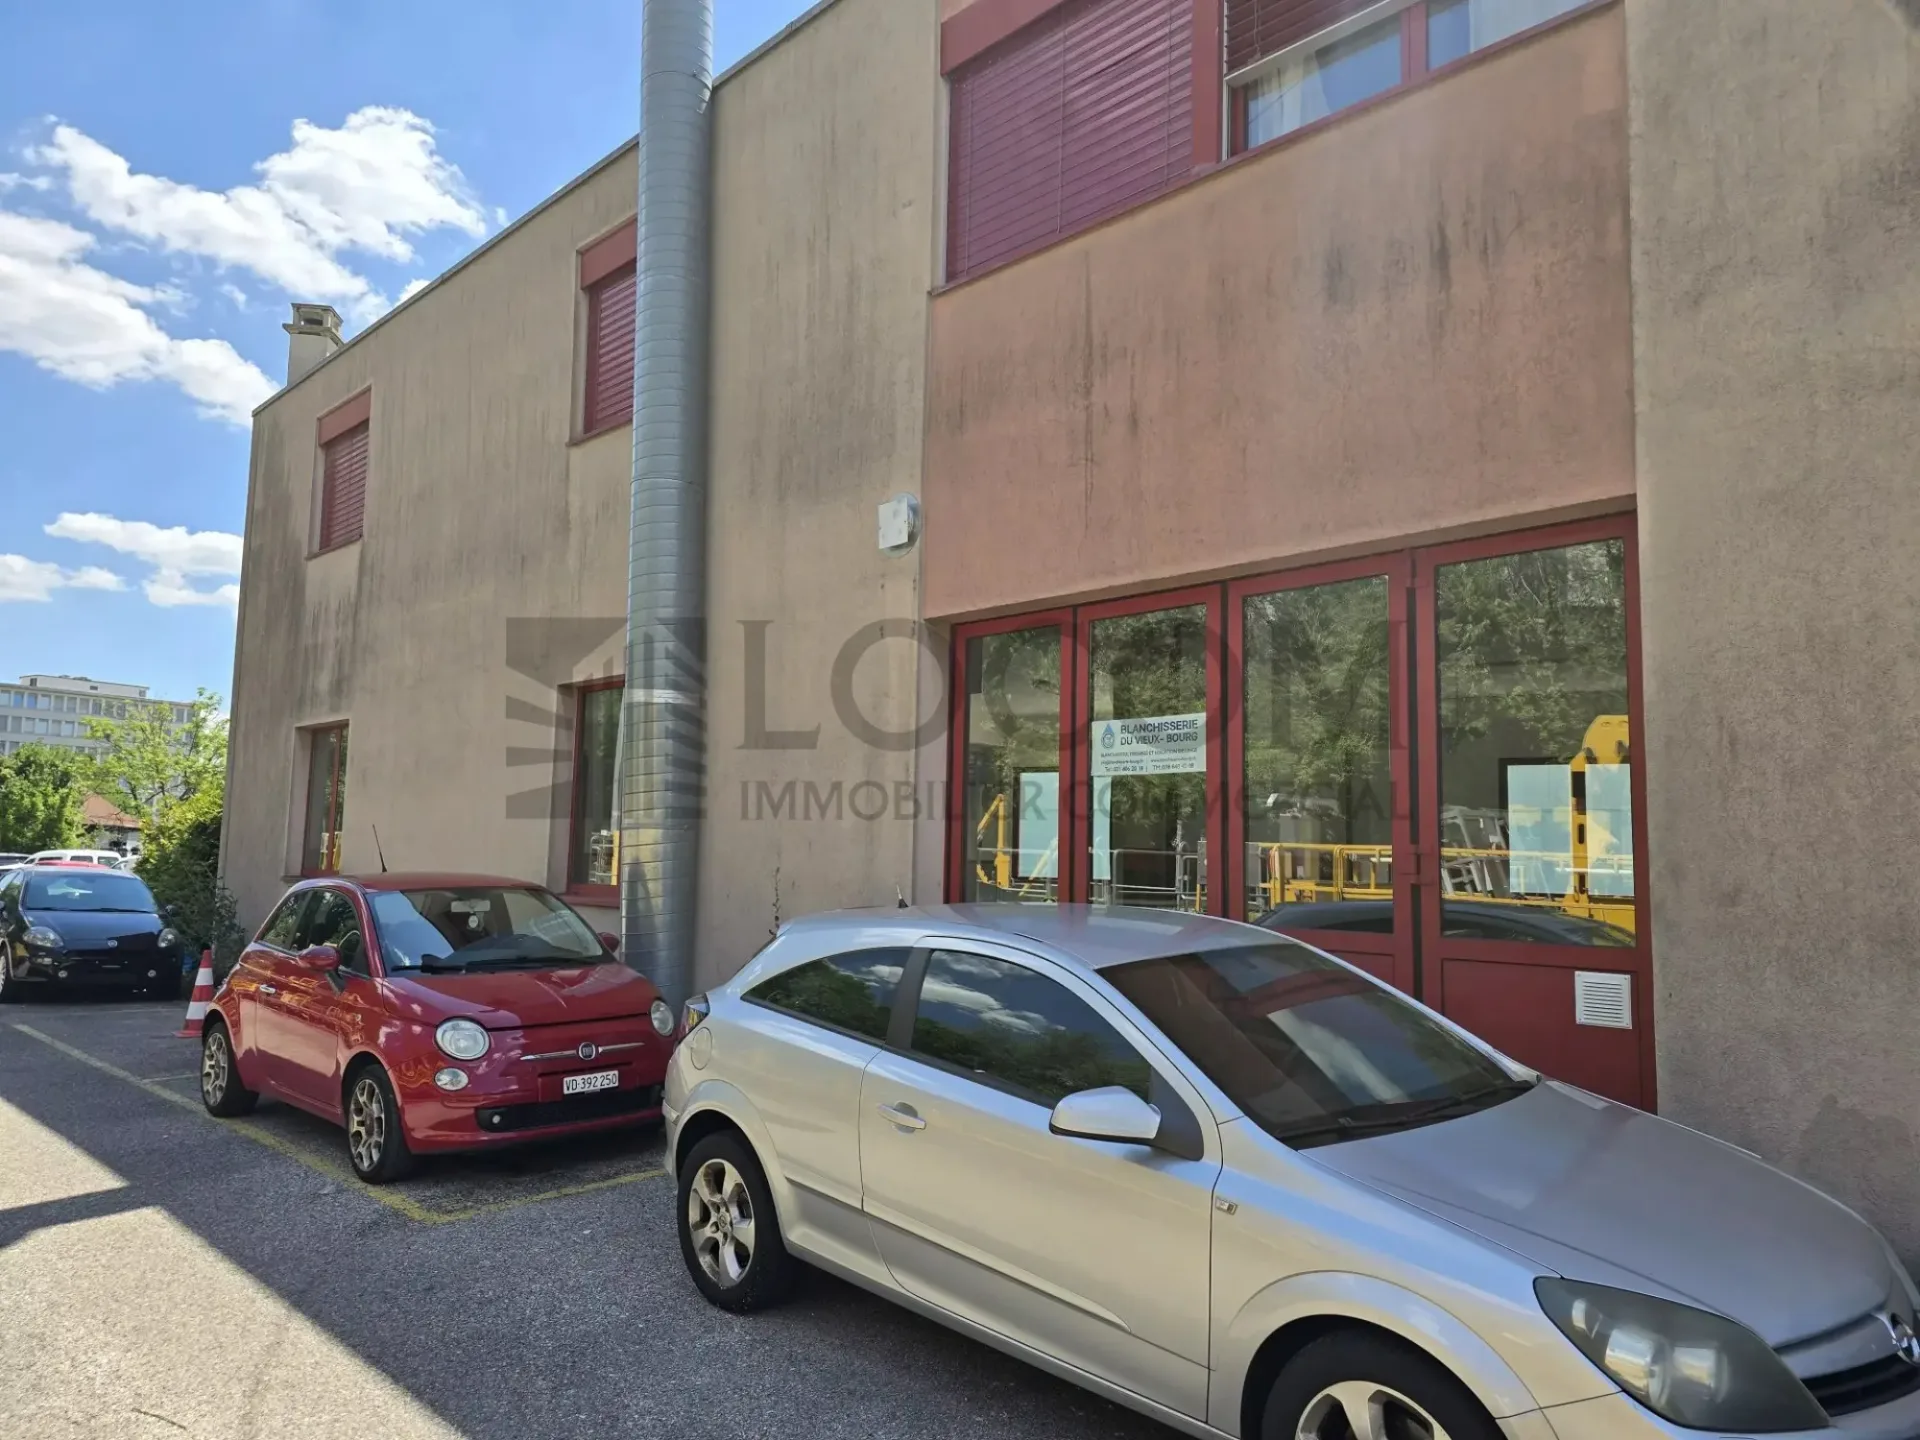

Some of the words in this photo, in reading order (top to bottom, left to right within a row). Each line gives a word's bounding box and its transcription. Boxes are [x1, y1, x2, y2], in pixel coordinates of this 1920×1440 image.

[1120, 719, 1198, 734] BLANCHISSERIE
[1120, 736, 1133, 746] DU
[1166, 732, 1198, 743] BOURG
